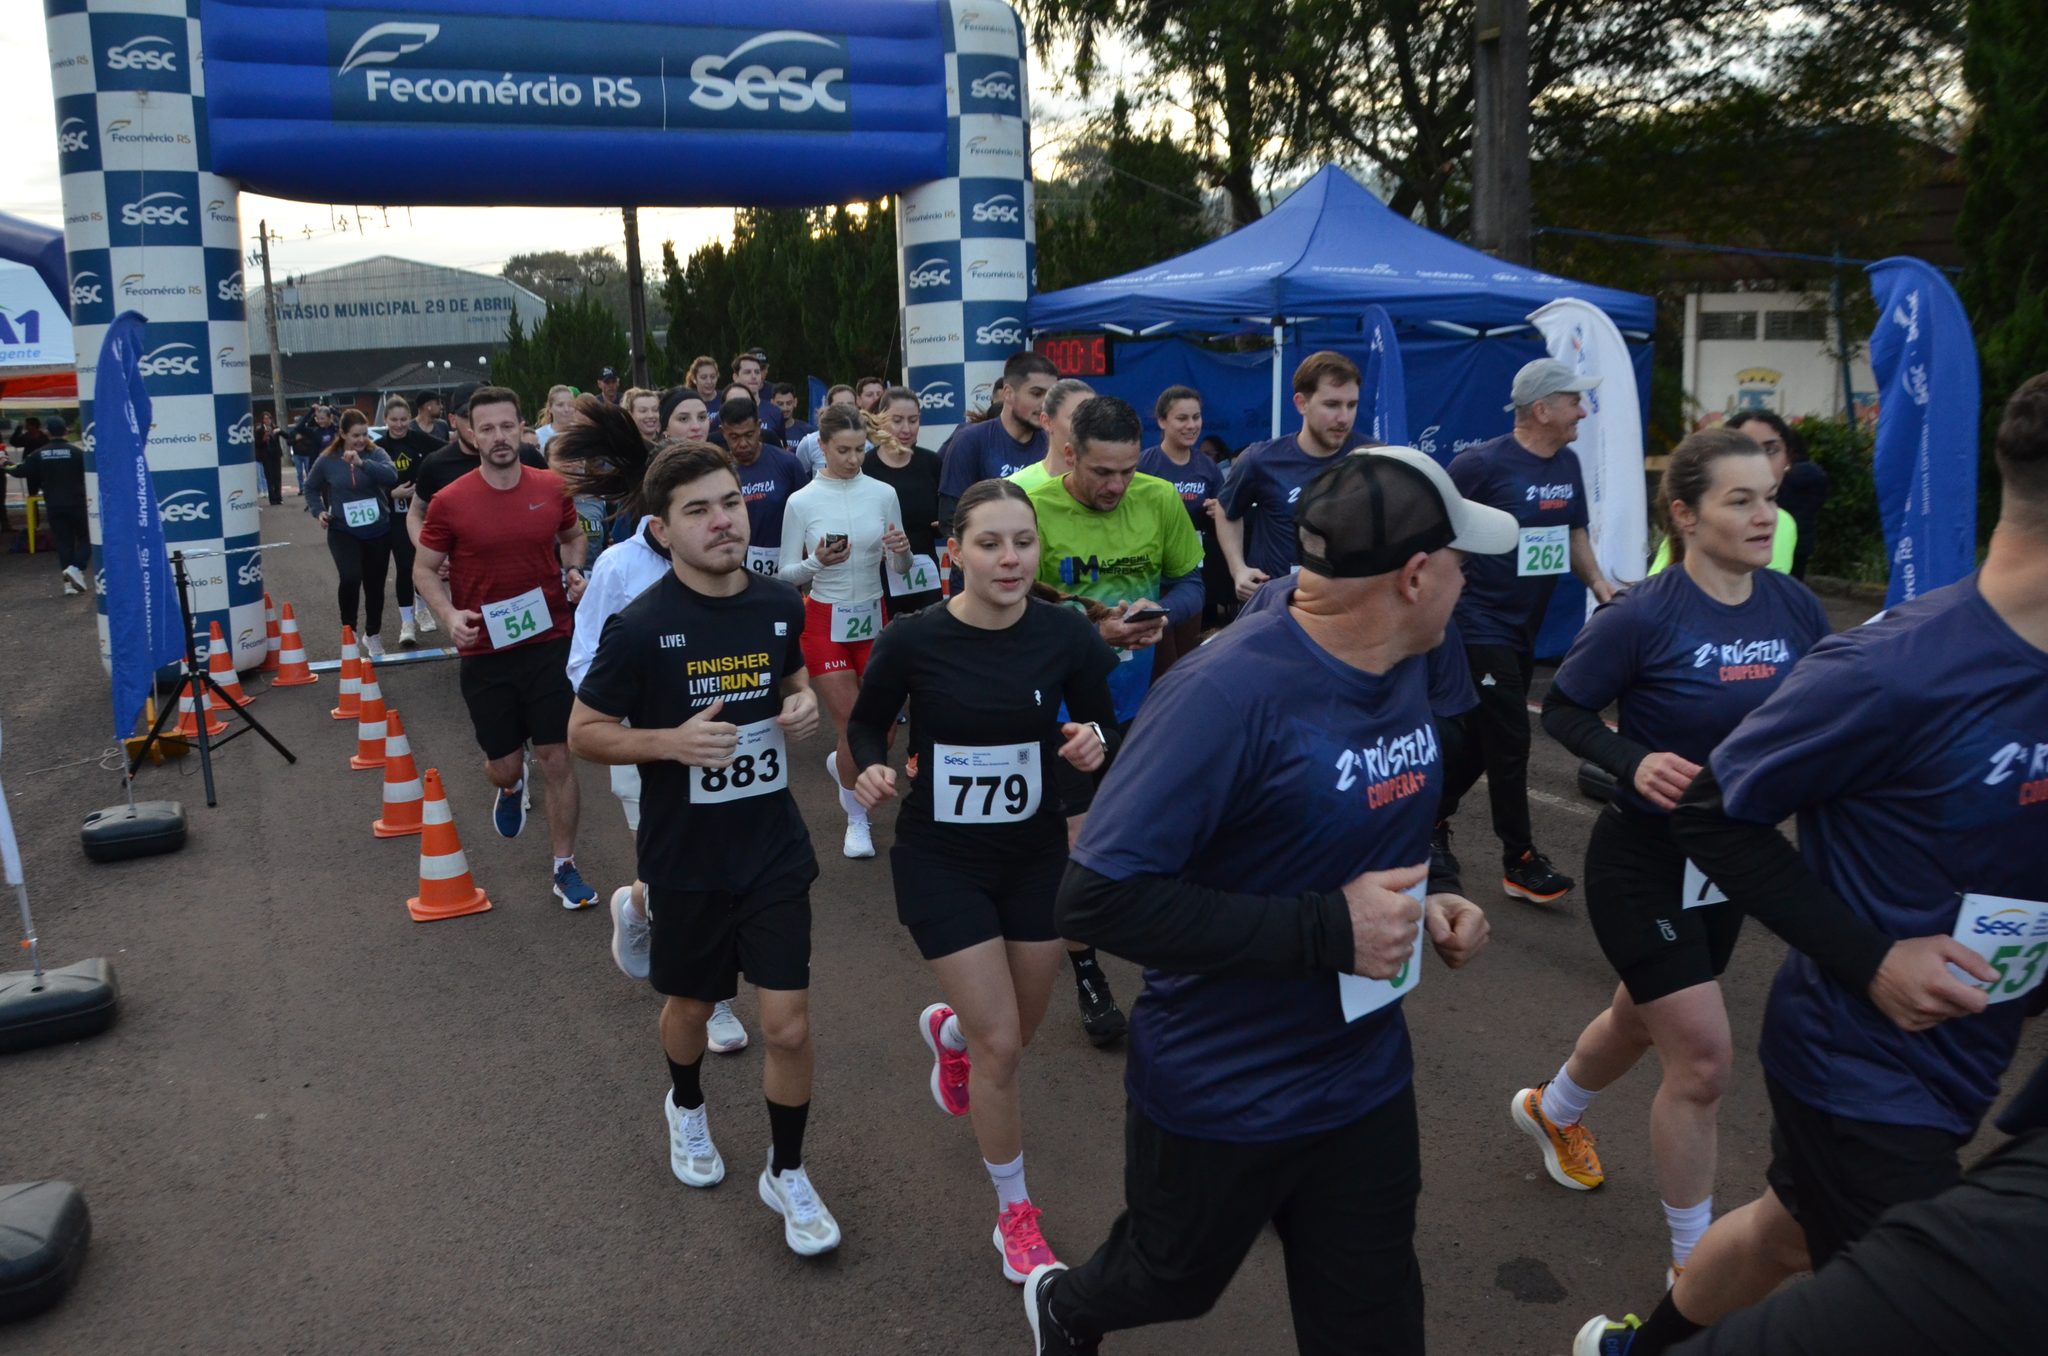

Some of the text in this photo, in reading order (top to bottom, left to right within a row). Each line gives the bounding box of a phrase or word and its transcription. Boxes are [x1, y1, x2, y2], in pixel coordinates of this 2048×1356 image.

[107, 46, 176, 71] Sesc
[367, 70, 641, 108] Fecomércio RS
[689, 54, 846, 113] Sesc
[971, 79, 1016, 100] Sesc
[112, 132, 191, 144] Fecomércio RS
[91, 212, 103, 222] RS
[122, 203, 188, 225] Sesc
[972, 203, 1019, 223] Sesc
[909, 268, 951, 288] Sesc
[125, 287, 202, 296] Fecomércio RS
[335, 301, 420, 318] MUNICIPAL
[425, 299, 445, 314] 29
[449, 298, 468, 313] DE
[976, 326, 1022, 345] Sesc
[137, 353, 199, 376] Sesc
[199, 433, 213, 442] RS
[135, 455, 148, 527] Sindicatos
[350, 507, 376, 524] 219
[1526, 544, 1564, 571] 262
[210, 576, 223, 585] RS
[504, 609, 536, 639] 54
[847, 615, 872, 639] 24
[660, 634, 686, 648] LIVE!
[687, 652, 770, 676] FINISHER
[825, 660, 847, 670] RUN
[944, 755, 969, 766] Sesc
[1363, 724, 1438, 781] RÚSTICA
[701, 749, 780, 792] 883
[949, 774, 1028, 816] 779
[1367, 772, 1427, 810] COOPERA+
[1974, 915, 2029, 937] Sesc
